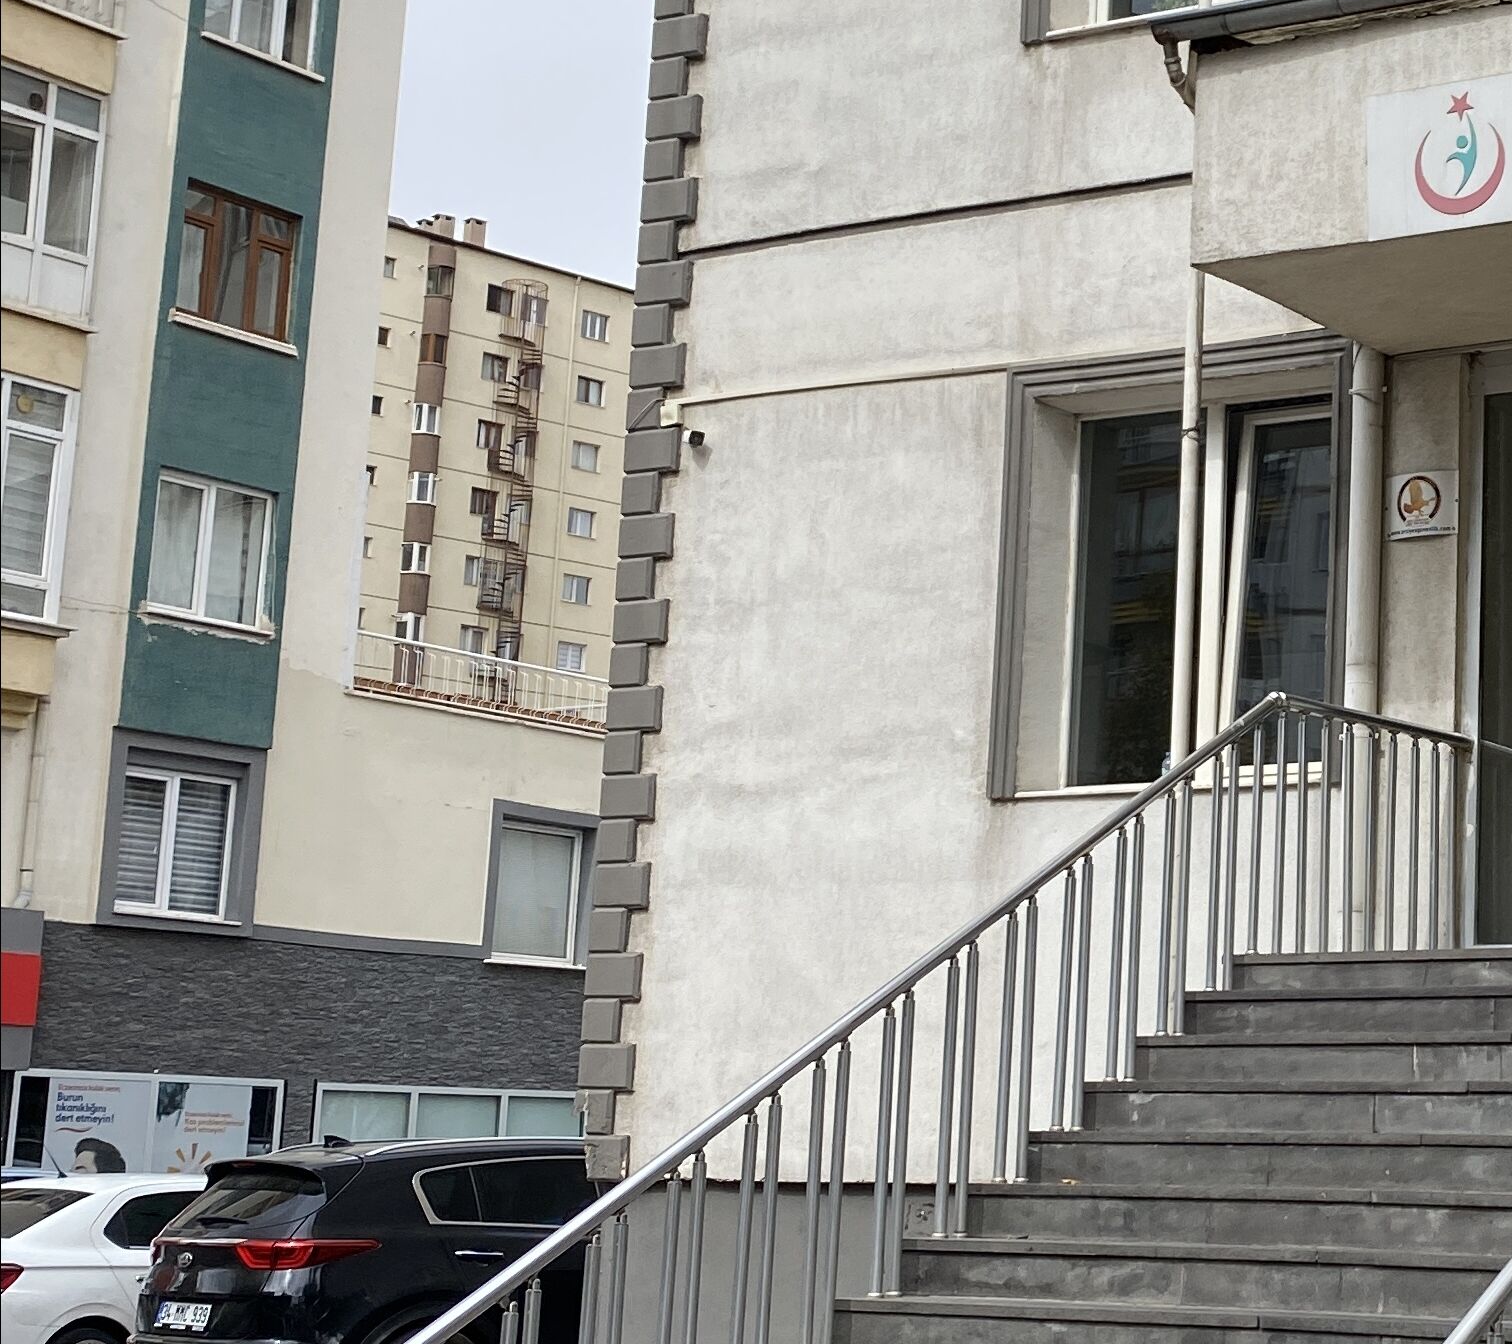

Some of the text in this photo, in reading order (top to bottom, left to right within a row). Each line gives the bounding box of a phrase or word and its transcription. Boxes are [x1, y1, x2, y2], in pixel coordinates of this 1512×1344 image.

[57, 1091, 83, 1102] Burun
[55, 1114, 115, 1126] dert etmeyin!
[191, 1306, 208, 1323] 939
